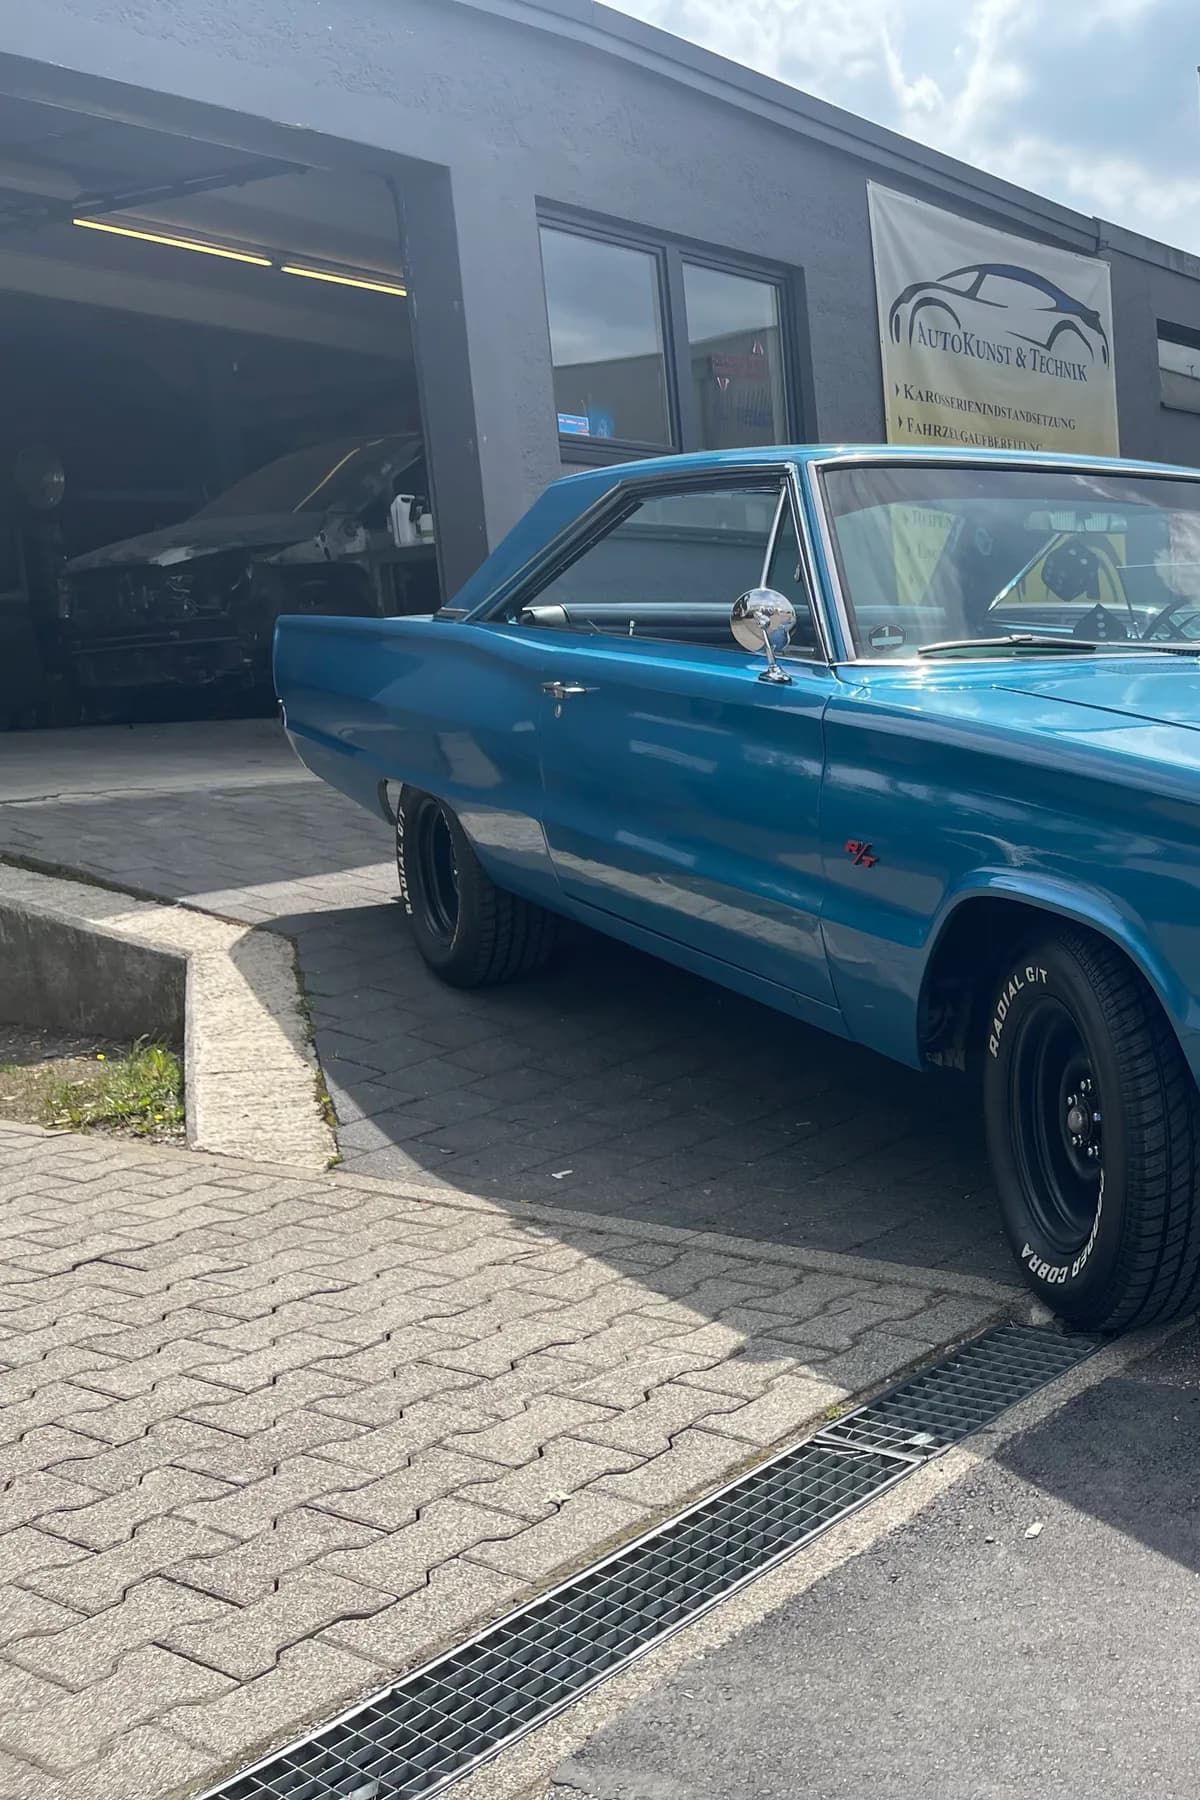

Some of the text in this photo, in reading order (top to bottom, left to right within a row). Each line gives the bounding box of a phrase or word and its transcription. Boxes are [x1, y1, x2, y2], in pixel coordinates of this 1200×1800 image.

[1016, 348, 1027, 369] &
[1030, 348, 1088, 382] TECHNIK
[1025, 966, 1048, 984] G/T
[988, 975, 1025, 1059] RADIAL
[1021, 1242, 1069, 1284] COBRA
